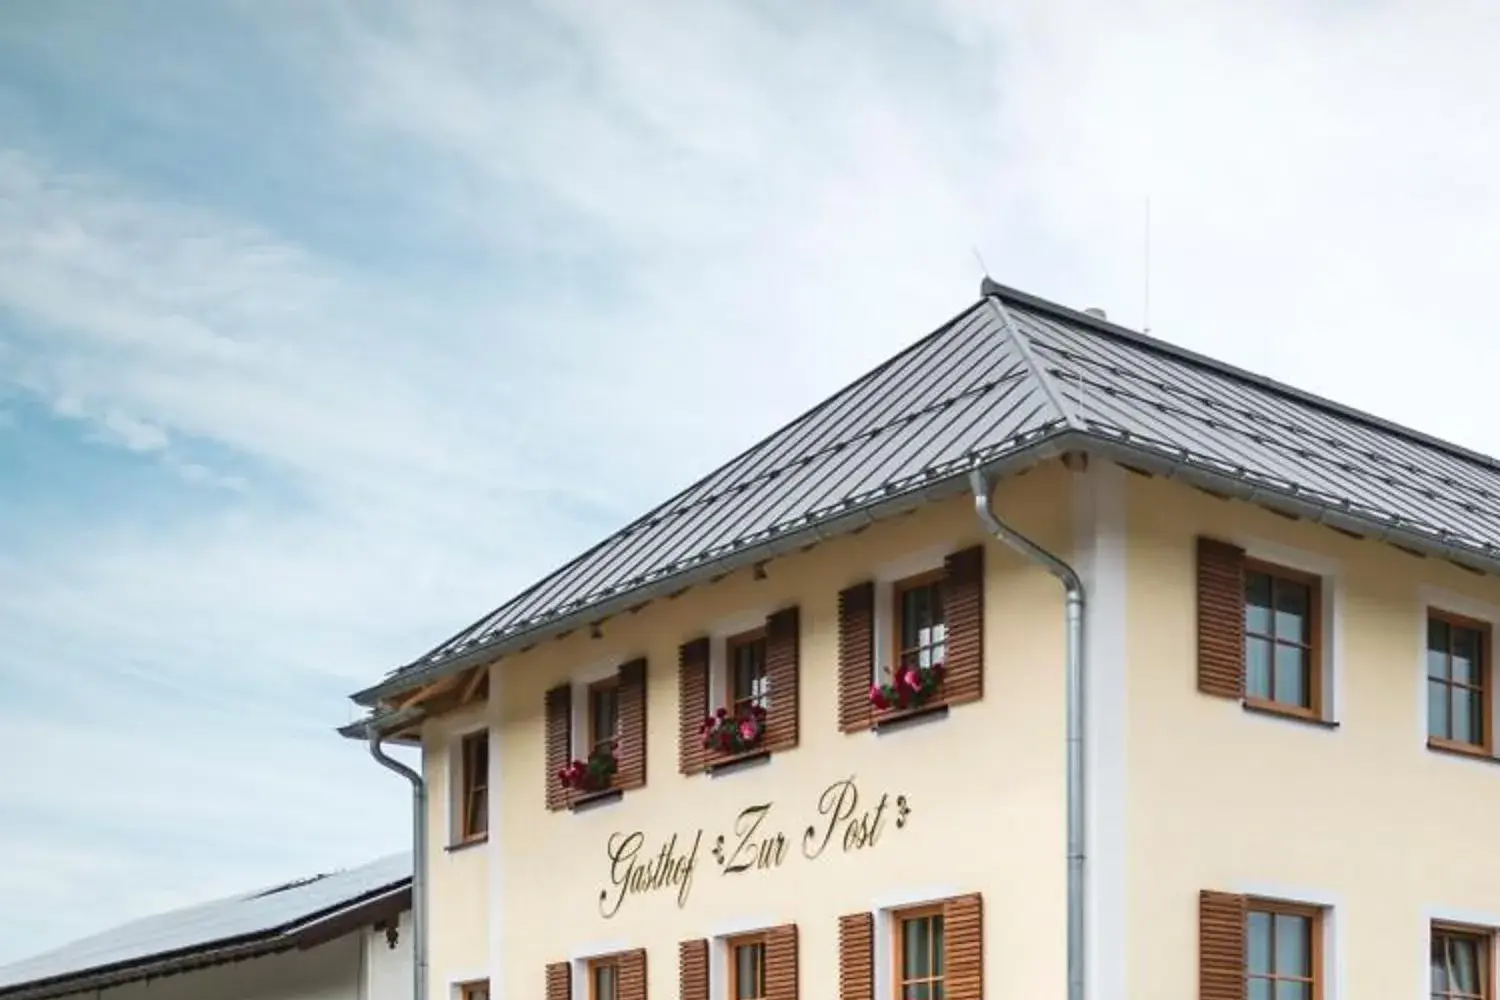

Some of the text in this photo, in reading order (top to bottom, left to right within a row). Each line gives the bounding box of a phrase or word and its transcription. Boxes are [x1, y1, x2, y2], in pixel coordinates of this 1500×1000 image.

[599, 774, 889, 918] Gasthof Zur Post
